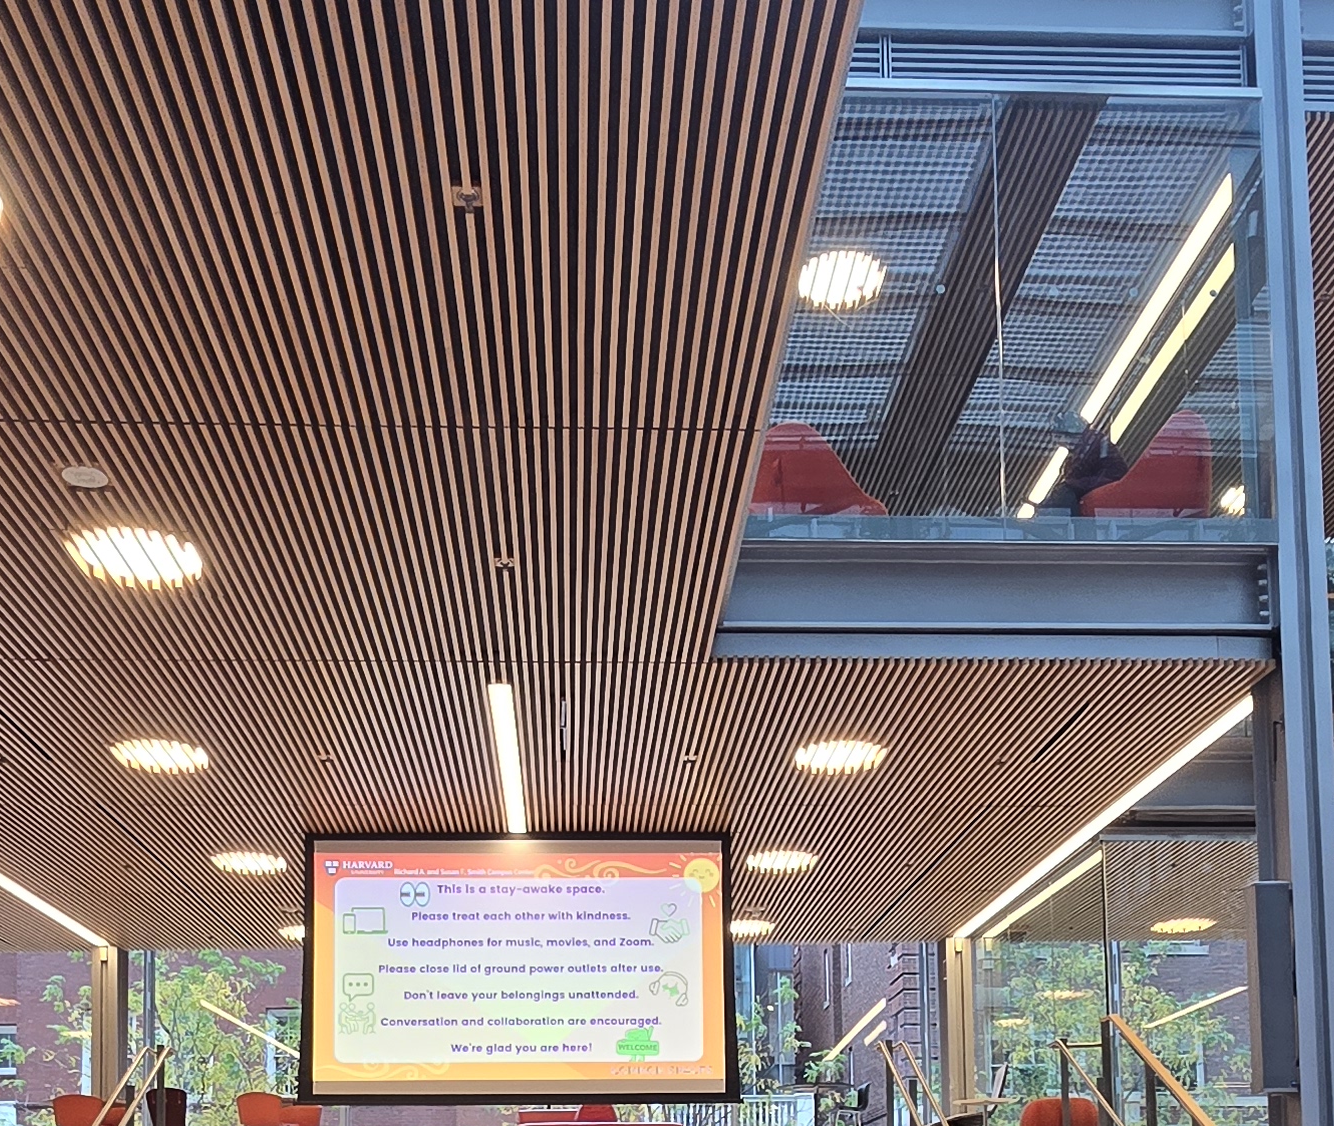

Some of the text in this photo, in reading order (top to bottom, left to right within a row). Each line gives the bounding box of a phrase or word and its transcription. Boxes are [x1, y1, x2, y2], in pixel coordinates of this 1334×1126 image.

[343, 860, 393, 869] HARVARD
[437, 884, 605, 897] This is a stay-awake space.
[412, 910, 631, 921] Please treat each other with kindness.
[387, 937, 655, 949] Use headphones for music, movies, and Zoom.
[378, 963, 664, 976] Please close lid of ground power outlets after use.
[404, 989, 639, 1002] Don't leave your belongings unattended.
[380, 1016, 662, 1028] Conversation and collaboration are encouraged.
[451, 1043, 593, 1055] We're glad you are here!
[618, 1044, 658, 1052] WELCOME
